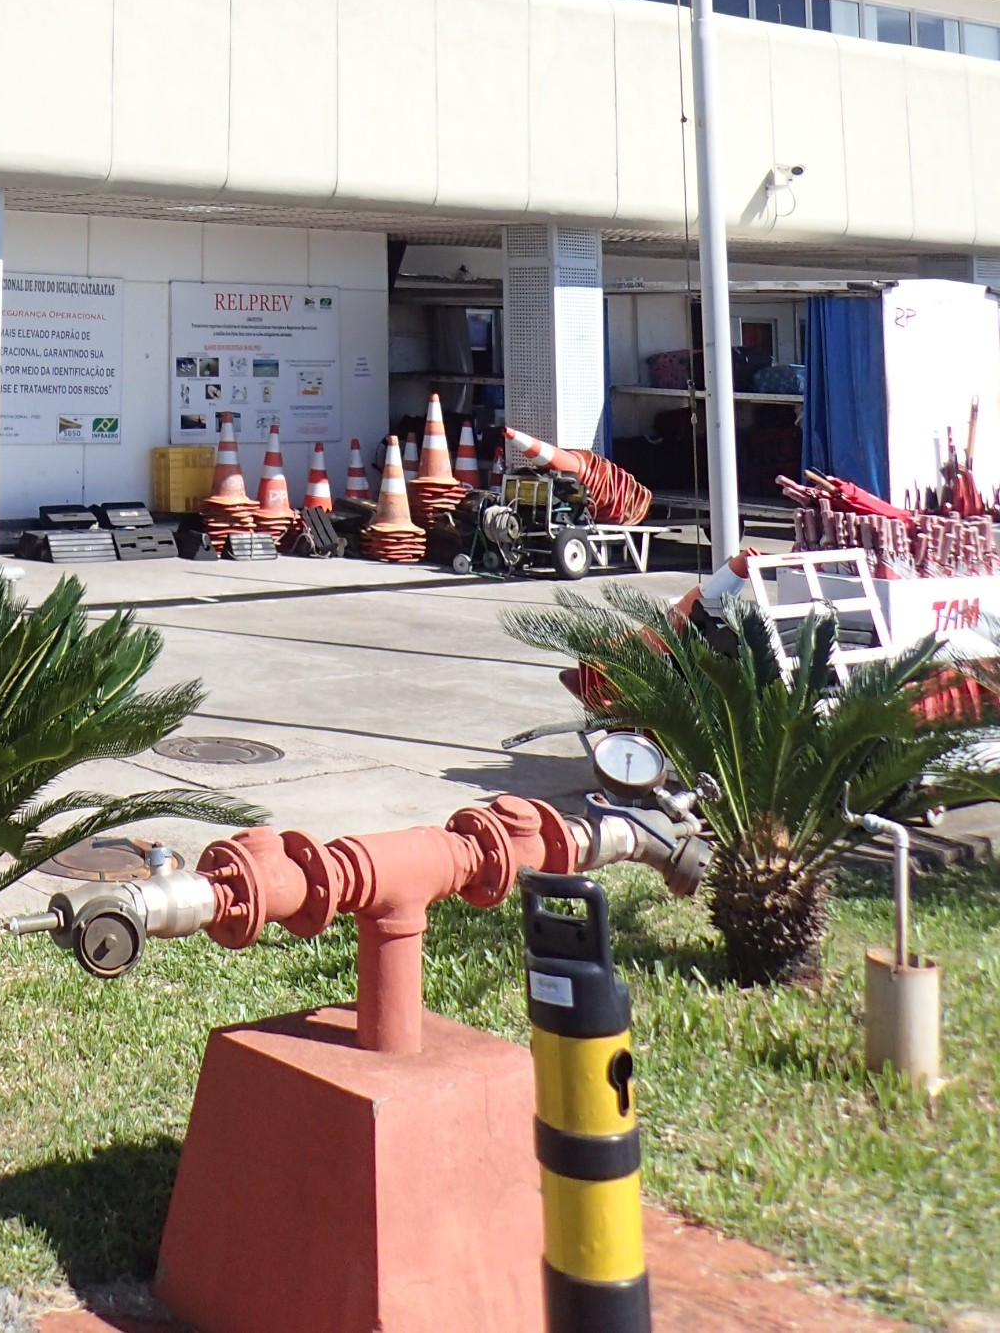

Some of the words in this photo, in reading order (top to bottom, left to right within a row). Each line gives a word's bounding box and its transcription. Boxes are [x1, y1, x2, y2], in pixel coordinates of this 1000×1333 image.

[25, 280, 33, 292] DE
[34, 280, 45, 293] FOZ
[46, 281, 55, 293] DO
[215, 293, 294, 312] RELPREV
[17, 328, 50, 339] ELEVADO
[51, 328, 80, 340] PADRÃO
[81, 331, 91, 341] DE
[43, 348, 89, 359] GARANTINDO
[90, 349, 104, 359] SUA
[5, 365, 20, 375] POR
[21, 366, 39, 376] MEIO
[40, 366, 50, 376] DA
[52, 365, 105, 379] IDENTIFICAÇÃO
[105, 368, 115, 377] DE
[13, 384, 18, 394] E
[20, 384, 67, 395] TRATAMENTO
[68, 385, 82, 395] DOS
[932, 598, 979, 632] TAM
